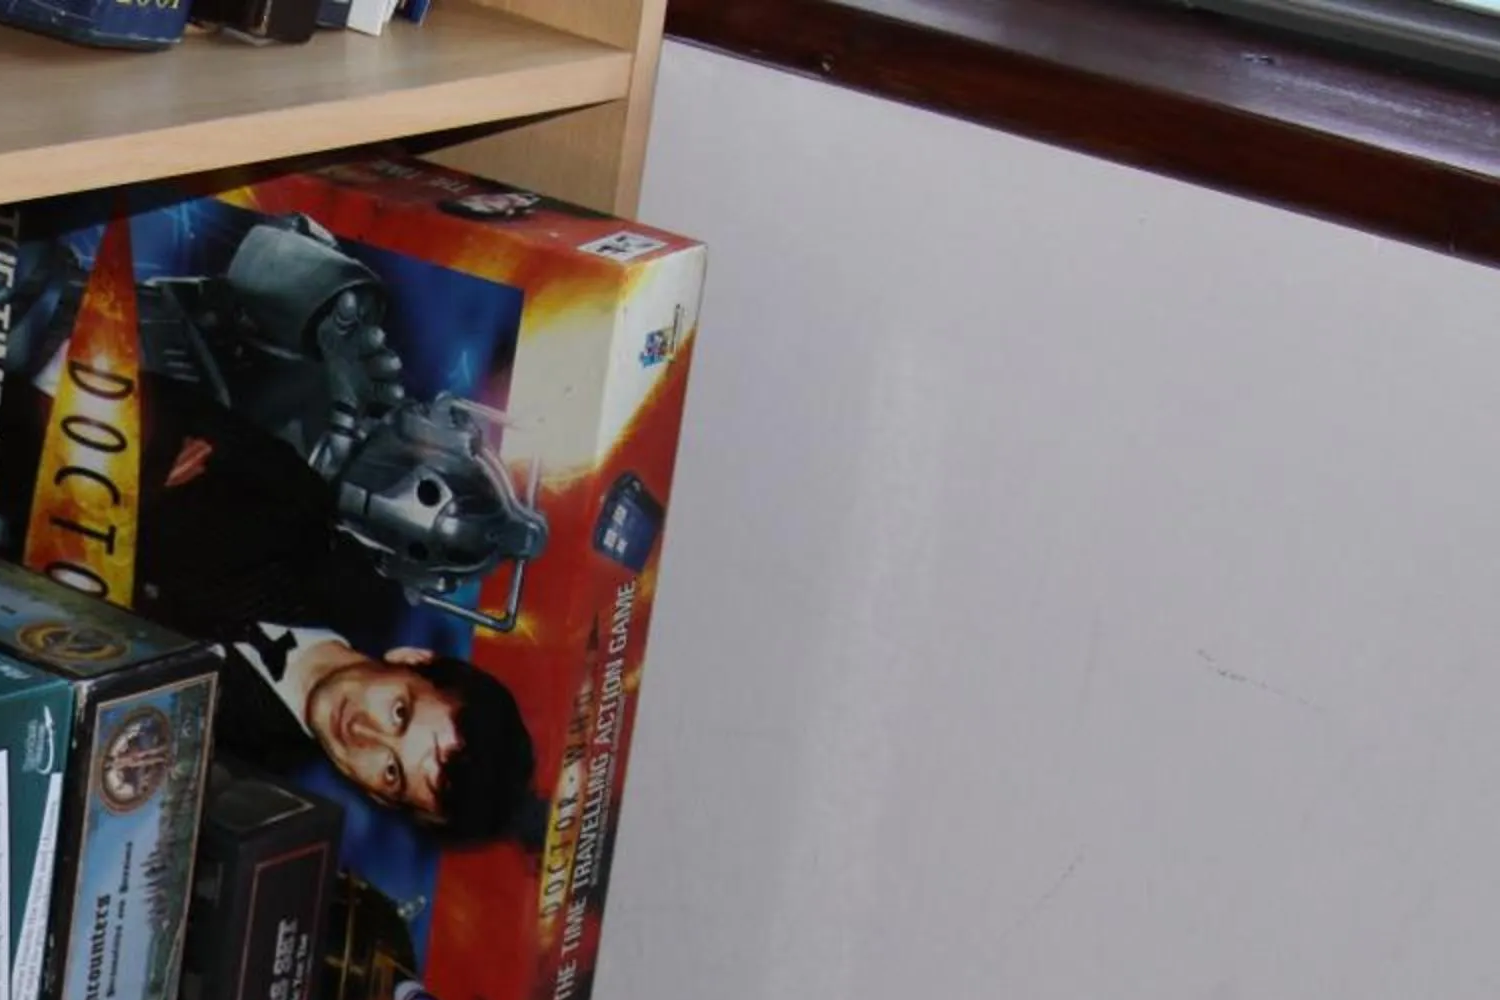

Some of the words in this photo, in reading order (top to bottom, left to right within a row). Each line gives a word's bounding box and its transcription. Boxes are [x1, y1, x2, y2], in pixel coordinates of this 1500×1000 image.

[609, 580, 635, 656] GAME
[594, 658, 623, 744] ACTION
[542, 791, 578, 919] DOCTOR
[572, 752, 609, 889] TRAVELLING
[274, 918, 298, 975] SET
[561, 897, 587, 956] TIME
